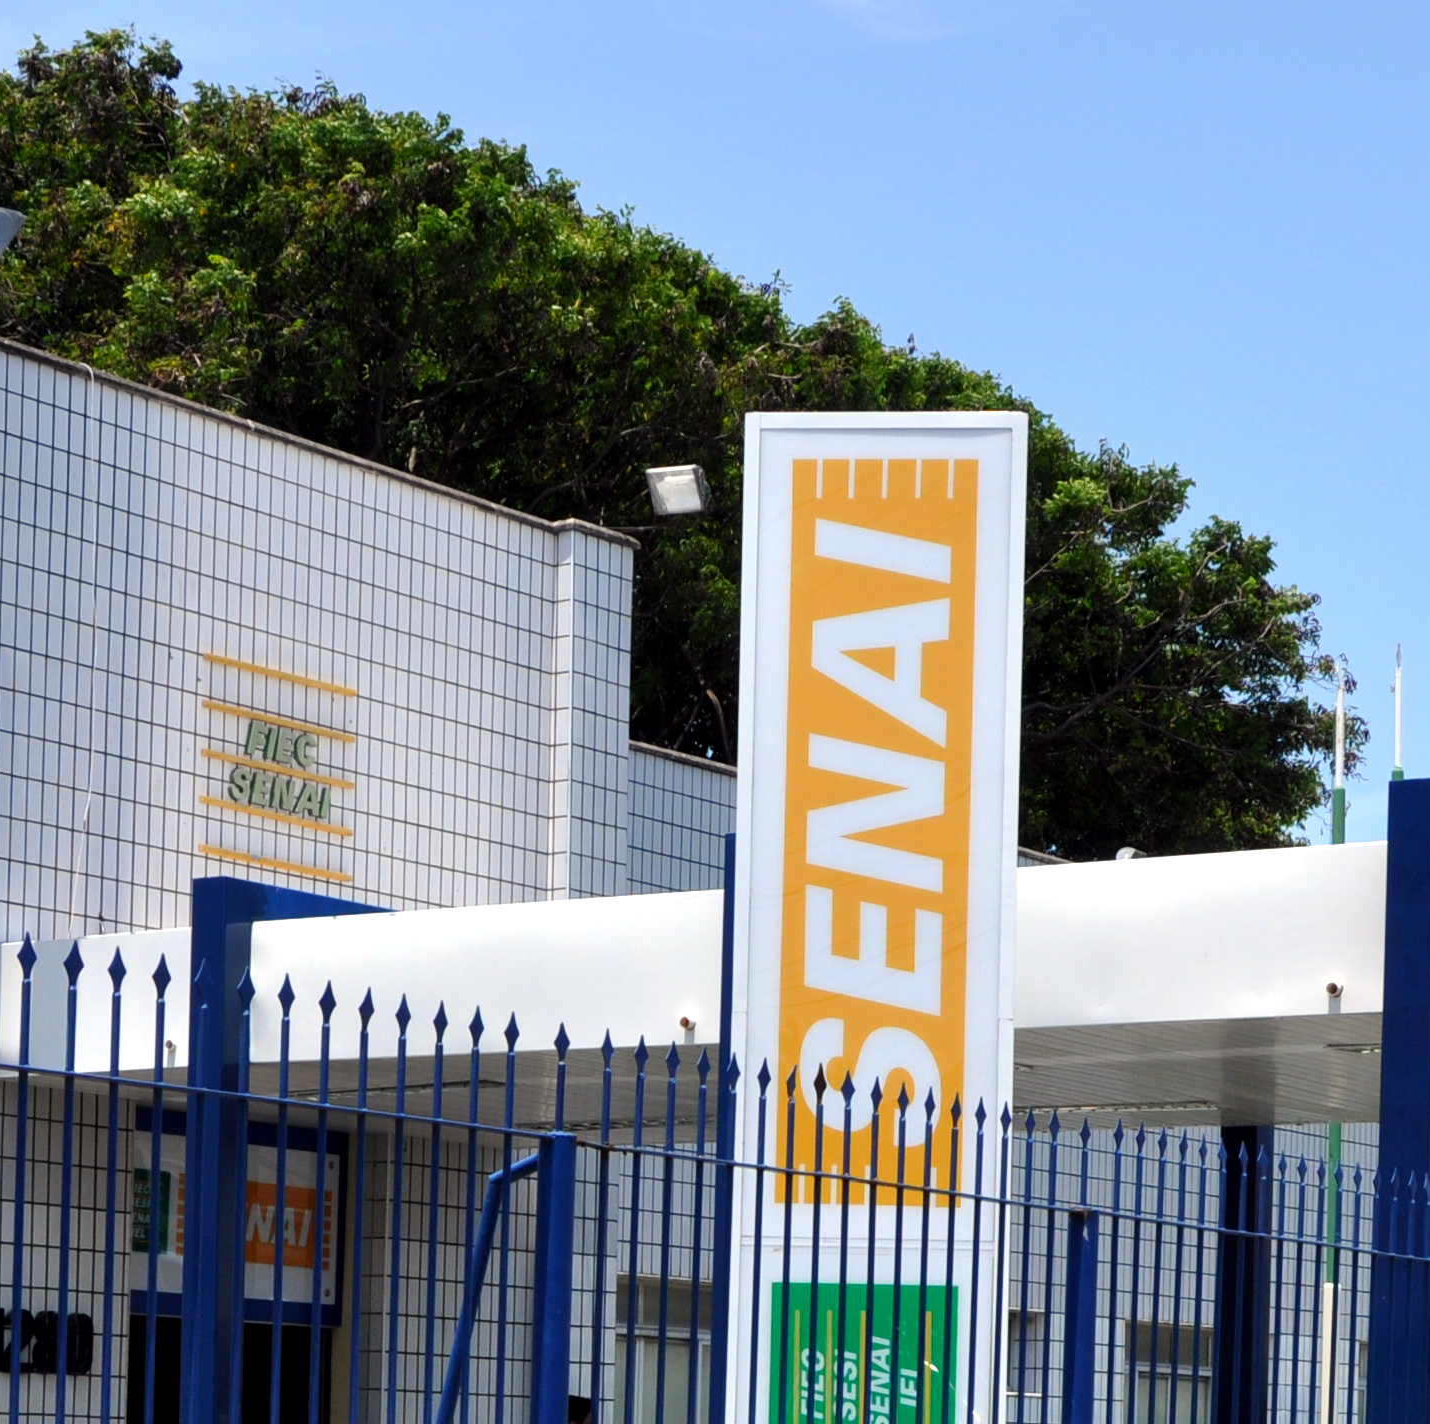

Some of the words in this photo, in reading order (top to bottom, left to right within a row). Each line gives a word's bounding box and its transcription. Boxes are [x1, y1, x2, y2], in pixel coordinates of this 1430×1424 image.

[245, 720, 318, 768] FIEC
[228, 767, 331, 819] SENAI
[799, 518, 952, 1148] SENAI
[801, 1347, 825, 1420] FIEC
[833, 1348, 858, 1422] SESI
